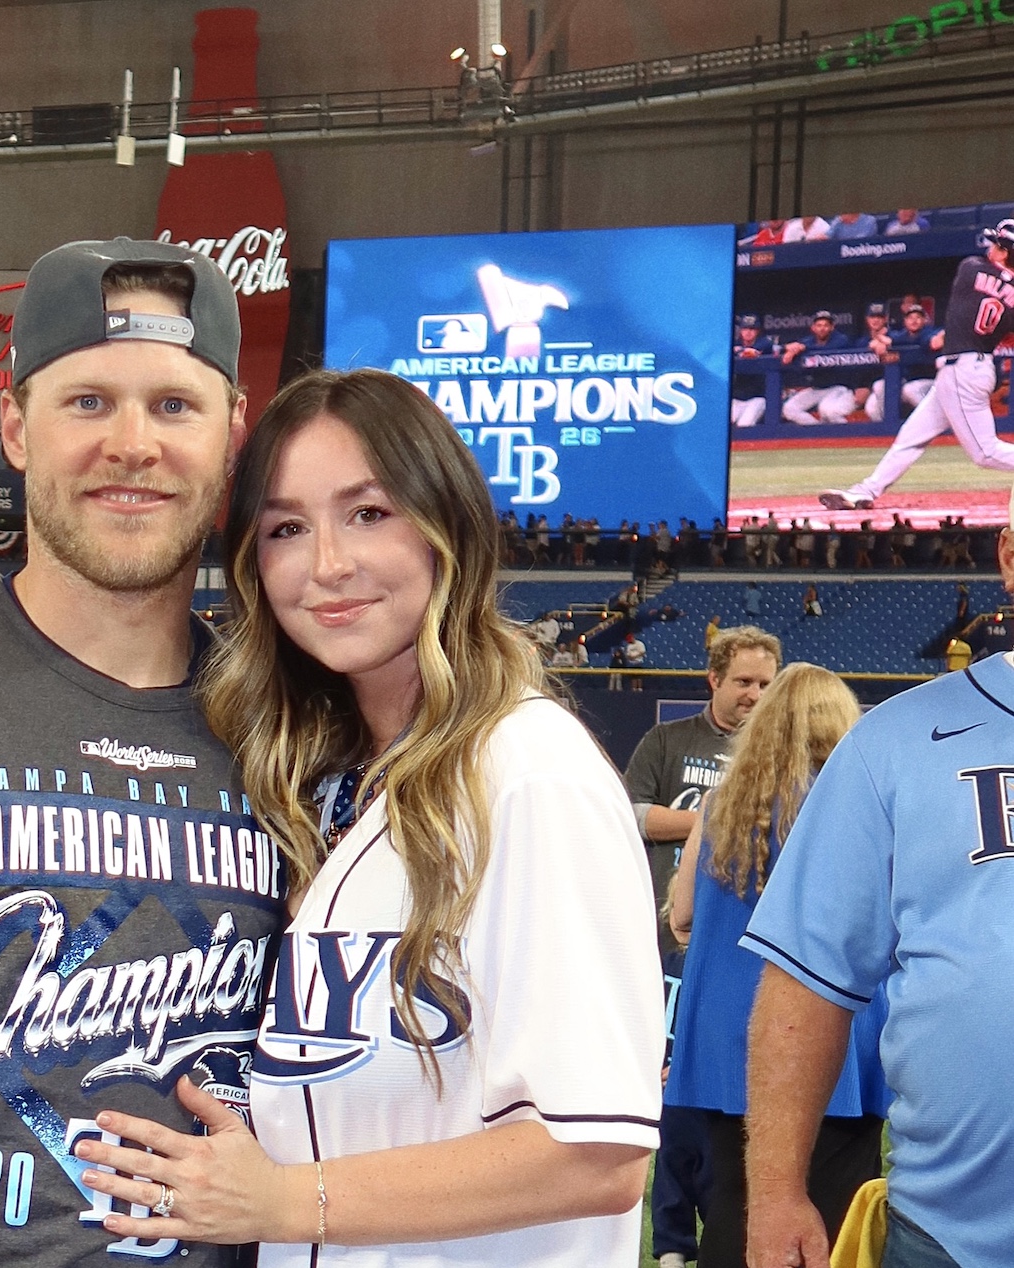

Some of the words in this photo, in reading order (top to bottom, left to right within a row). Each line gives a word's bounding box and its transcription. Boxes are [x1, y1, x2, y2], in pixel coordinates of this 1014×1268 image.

[840, 242, 907, 258] Booking.com
[390, 355, 539, 375] AMERICAN
[545, 353, 656, 373] LEAGUE
[413, 373, 698, 425] AMPIONS
[559, 427, 602, 446] 26
[478, 427, 562, 504] TB
[683, 765, 726, 788] AMERIC
[128, 778, 189, 807] BAY
[218, 790, 251, 815] RA
[184, 821, 280, 899] LEAGUE
[207, 1086, 249, 1100] MERICA
